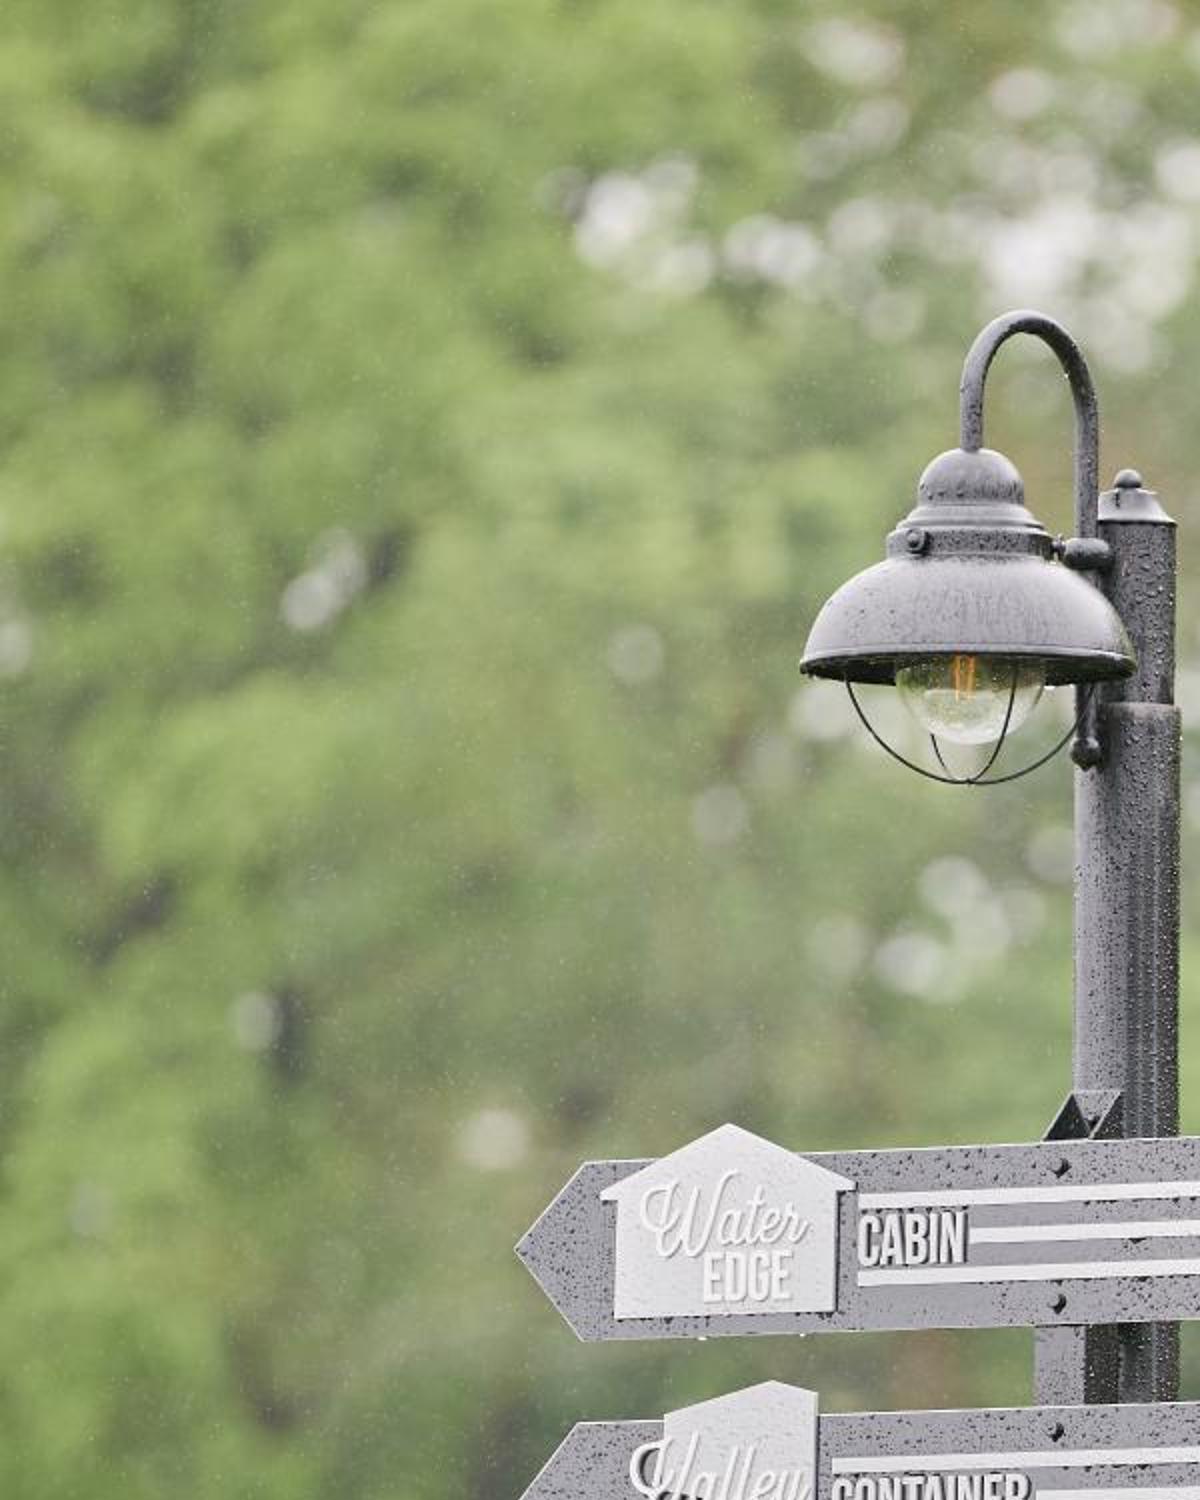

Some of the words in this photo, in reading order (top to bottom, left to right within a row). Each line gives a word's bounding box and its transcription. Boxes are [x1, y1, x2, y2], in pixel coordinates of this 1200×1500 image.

[642, 1172, 809, 1257] Water
[857, 1210, 970, 1267] CABIN
[703, 1250, 794, 1303] EDGE
